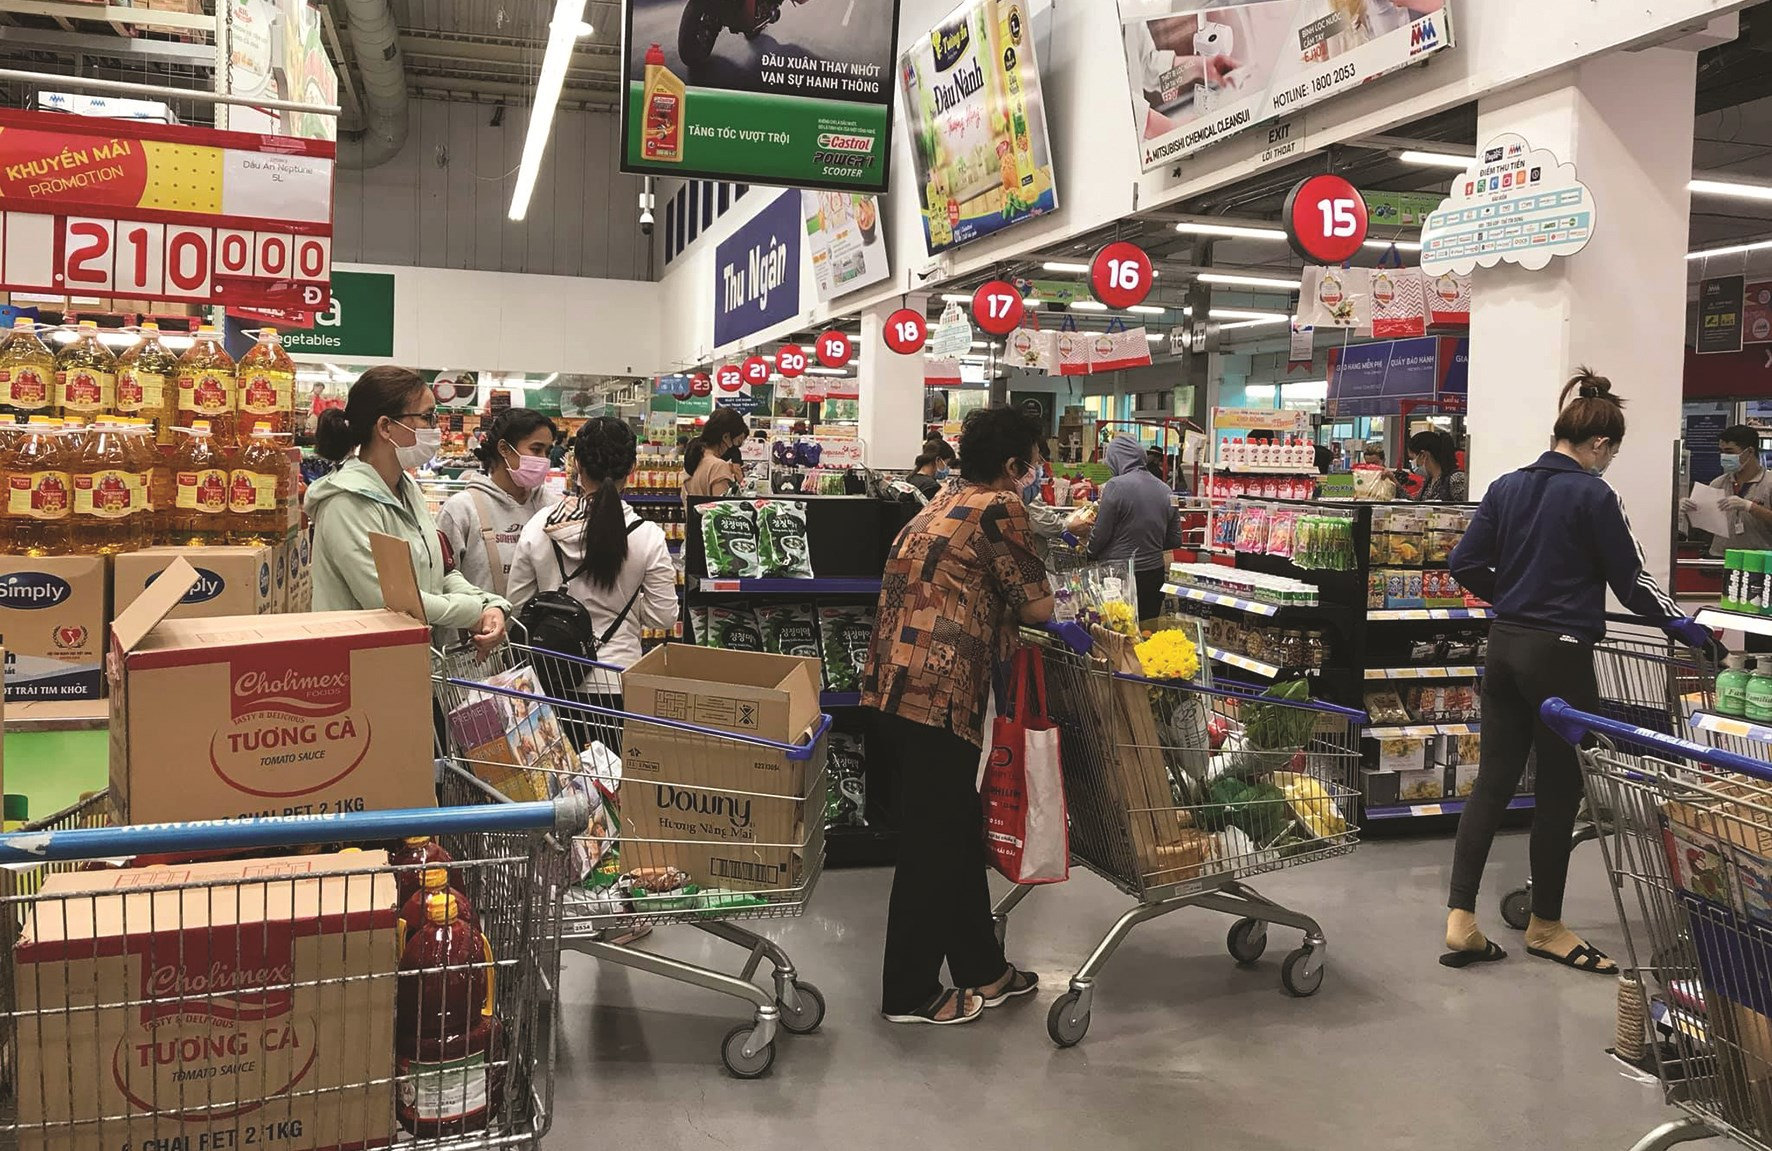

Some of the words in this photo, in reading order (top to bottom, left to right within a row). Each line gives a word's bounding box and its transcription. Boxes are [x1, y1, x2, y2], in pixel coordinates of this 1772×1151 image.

[761, 54, 784, 69] ĐẦU
[787, 57, 817, 72] XUÂN
[820, 60, 848, 75] THAY
[850, 62, 880, 77] NHỚT
[761, 71, 784, 86] VẠN
[787, 72, 804, 89] SỰ
[806, 75, 839, 89] HANH
[841, 76, 879, 93] THÔNG
[933, 83, 957, 116] Đậu
[953, 55, 985, 100] Nành
[1273, 83, 1309, 109] HOTLINE:
[1311, 76, 1332, 93] 1800
[1334, 63, 1356, 84] 2053
[688, 125, 714, 137] TĂNG
[717, 125, 737, 140] TỐC
[739, 129, 766, 144] VƯỢT
[767, 131, 790, 145] TRỘI
[831, 136, 870, 151] Castrol
[1152, 139, 1186, 161] MITSUBISHI
[1185, 123, 1217, 147] CHEMICAL
[1217, 108, 1250, 132] CLEANSUI
[1268, 123, 1291, 144] EXIT
[6, 146, 87, 181] KHUYẾN
[93, 138, 131, 161] MÃI
[1479, 165, 1496, 177] ĐIỂM
[1497, 163, 1509, 174] THU
[1510, 160, 1525, 170] TIỀN
[29, 164, 125, 198] PROMOTION
[271, 173, 284, 183] 5L
[822, 166, 863, 178] SCOOTER
[1317, 198, 1357, 237] 15
[723, 262, 745, 313] Thu
[748, 235, 787, 311] Ngân
[1107, 259, 1139, 290] 16
[987, 294, 1014, 318] 17
[895, 321, 918, 342] 18
[825, 340, 844, 357] 19
[750, 363, 766, 378] 21
[781, 354, 804, 369] 20
[693, 380, 710, 390] 23
[721, 372, 740, 385] 22
[0, 577, 64, 601] Simply
[15, 684, 38, 695] TRÁI
[40, 686, 58, 694] TIM
[306, 689, 341, 698] FOODS
[233, 713, 258, 726] TASTY
[266, 711, 305, 724] DELICIOUS
[227, 724, 317, 753] TƯƠNG
[325, 715, 356, 740] CÀ
[260, 752, 296, 766] TOMATO
[298, 750, 326, 761] SAUCE
[656, 785, 751, 828] Downy
[660, 817, 697, 835] Hương
[731, 827, 752, 840] Mai
[136, 1033, 248, 1067] TƯƠNG
[260, 1021, 299, 1051] CÀ
[172, 1067, 216, 1083] TOMATO
[220, 1060, 255, 1076] SAUCE
